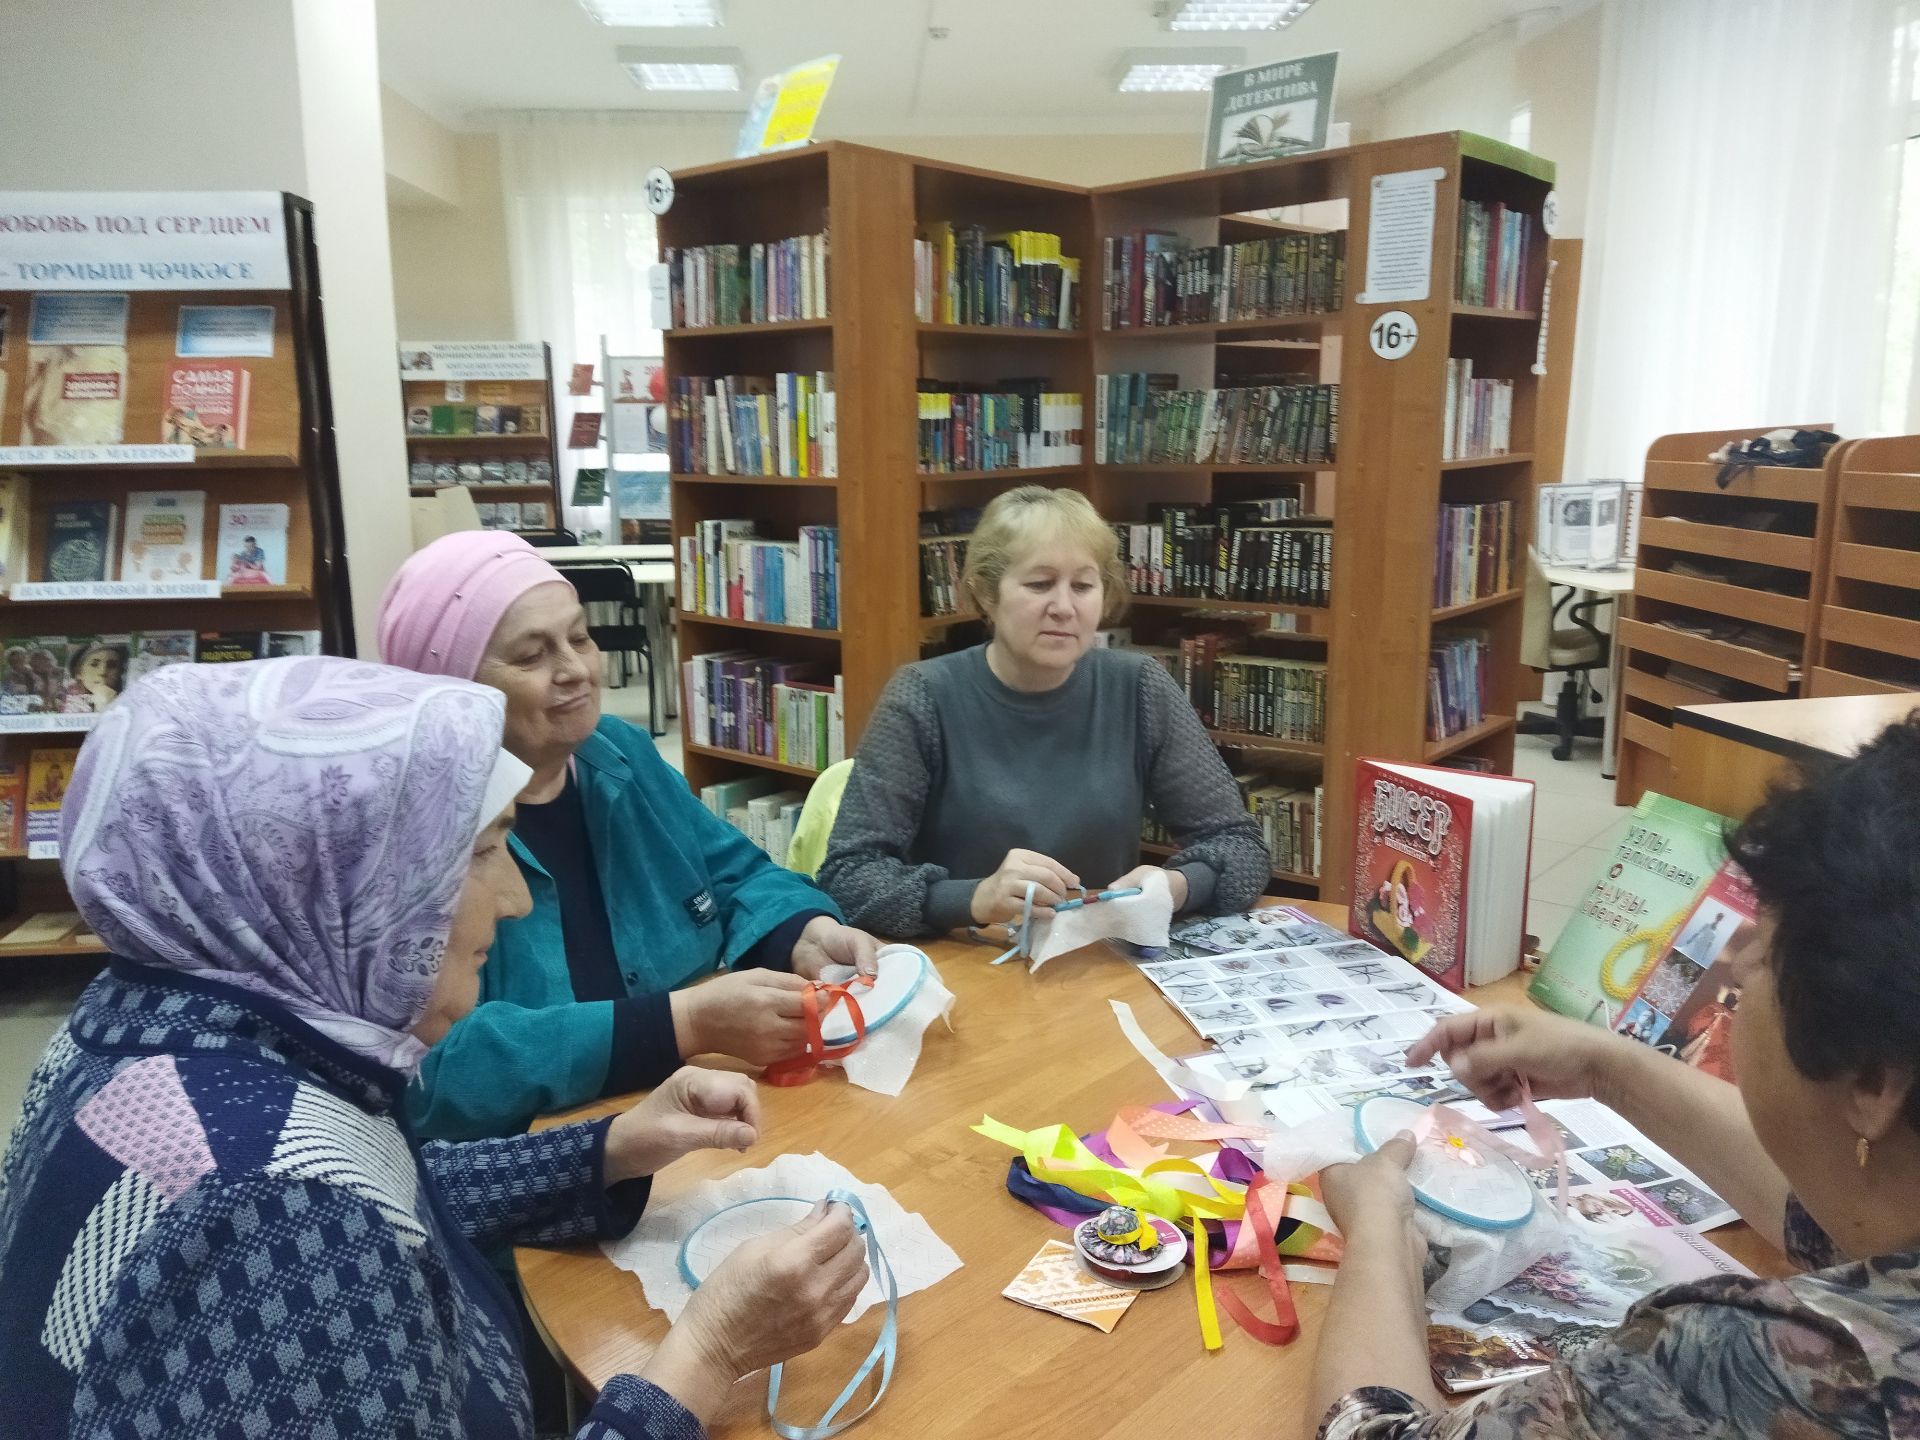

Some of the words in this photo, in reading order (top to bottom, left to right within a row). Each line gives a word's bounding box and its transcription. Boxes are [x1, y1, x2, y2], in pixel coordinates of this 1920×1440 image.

[1257, 61, 1305, 83] МИРЕ
[1223, 80, 1319, 113] ДЕТЕКТИВА
[94, 215, 150, 236] ПОД
[155, 215, 272, 235] СЕРДЦЕМ
[17, 262, 133, 281] ТОРМЫШ
[1372, 322, 1417, 349] 16+
[1373, 779, 1453, 855] БИСЕР
[1052, 1292, 1129, 1307] РУШНИЧОК
